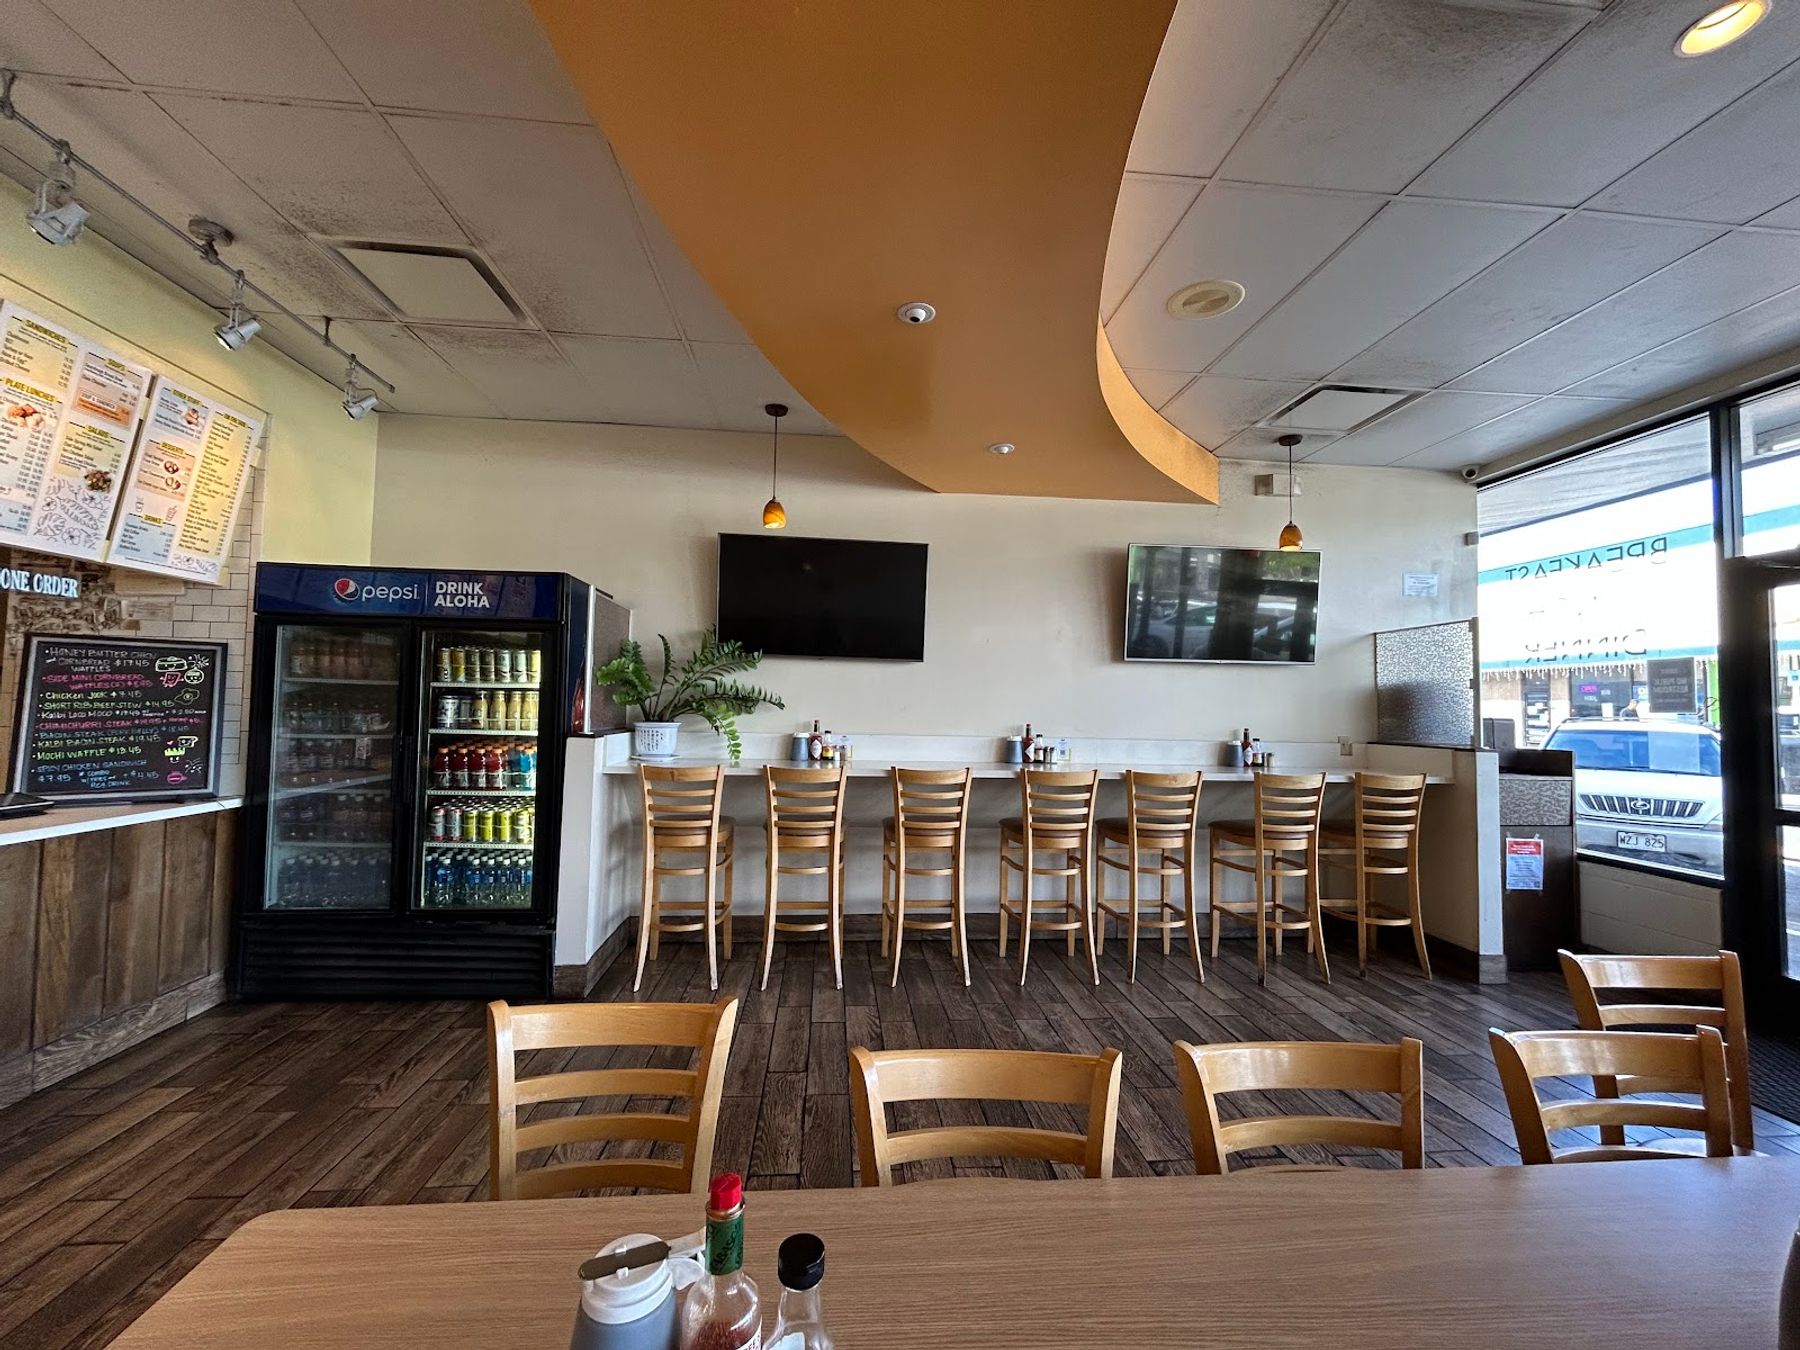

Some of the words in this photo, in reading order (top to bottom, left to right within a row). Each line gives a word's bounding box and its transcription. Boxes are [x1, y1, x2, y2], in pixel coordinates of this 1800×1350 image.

[6, 377, 26, 391] PLATE
[0, 568, 31, 592] ONE
[33, 573, 78, 598] ORDER
[436, 582, 483, 594] DRINK
[362, 584, 418, 603] pepsi
[434, 595, 490, 608] ALOHA
[45, 691, 85, 700] Chicken
[37, 751, 65, 760] MOCHI
